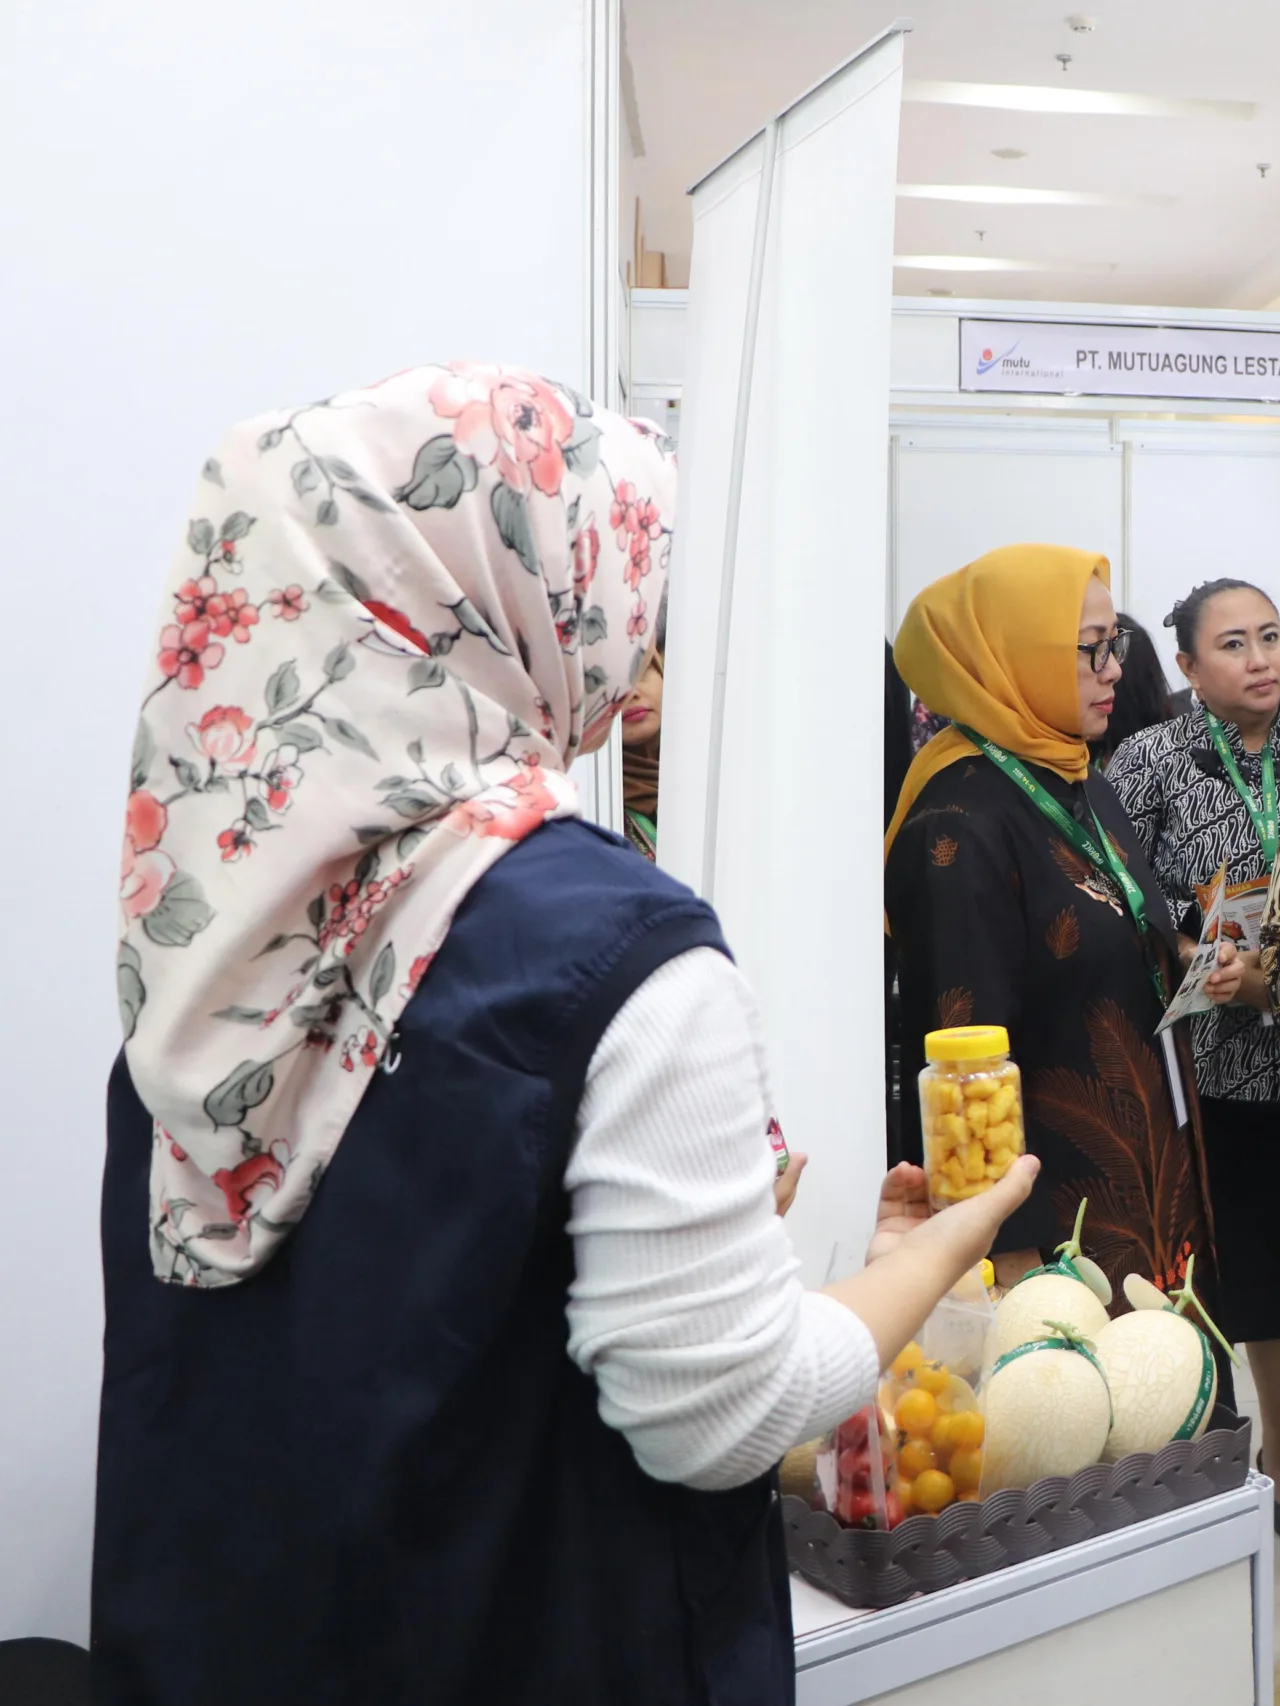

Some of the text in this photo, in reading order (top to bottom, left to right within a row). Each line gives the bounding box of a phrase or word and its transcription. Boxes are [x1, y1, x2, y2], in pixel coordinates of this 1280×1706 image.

[1002, 357, 1030, 368] mutu
[1076, 350, 1102, 370] PT.
[1108, 351, 1228, 375] MUTUAGUNG
[1001, 369, 1064, 378] international
